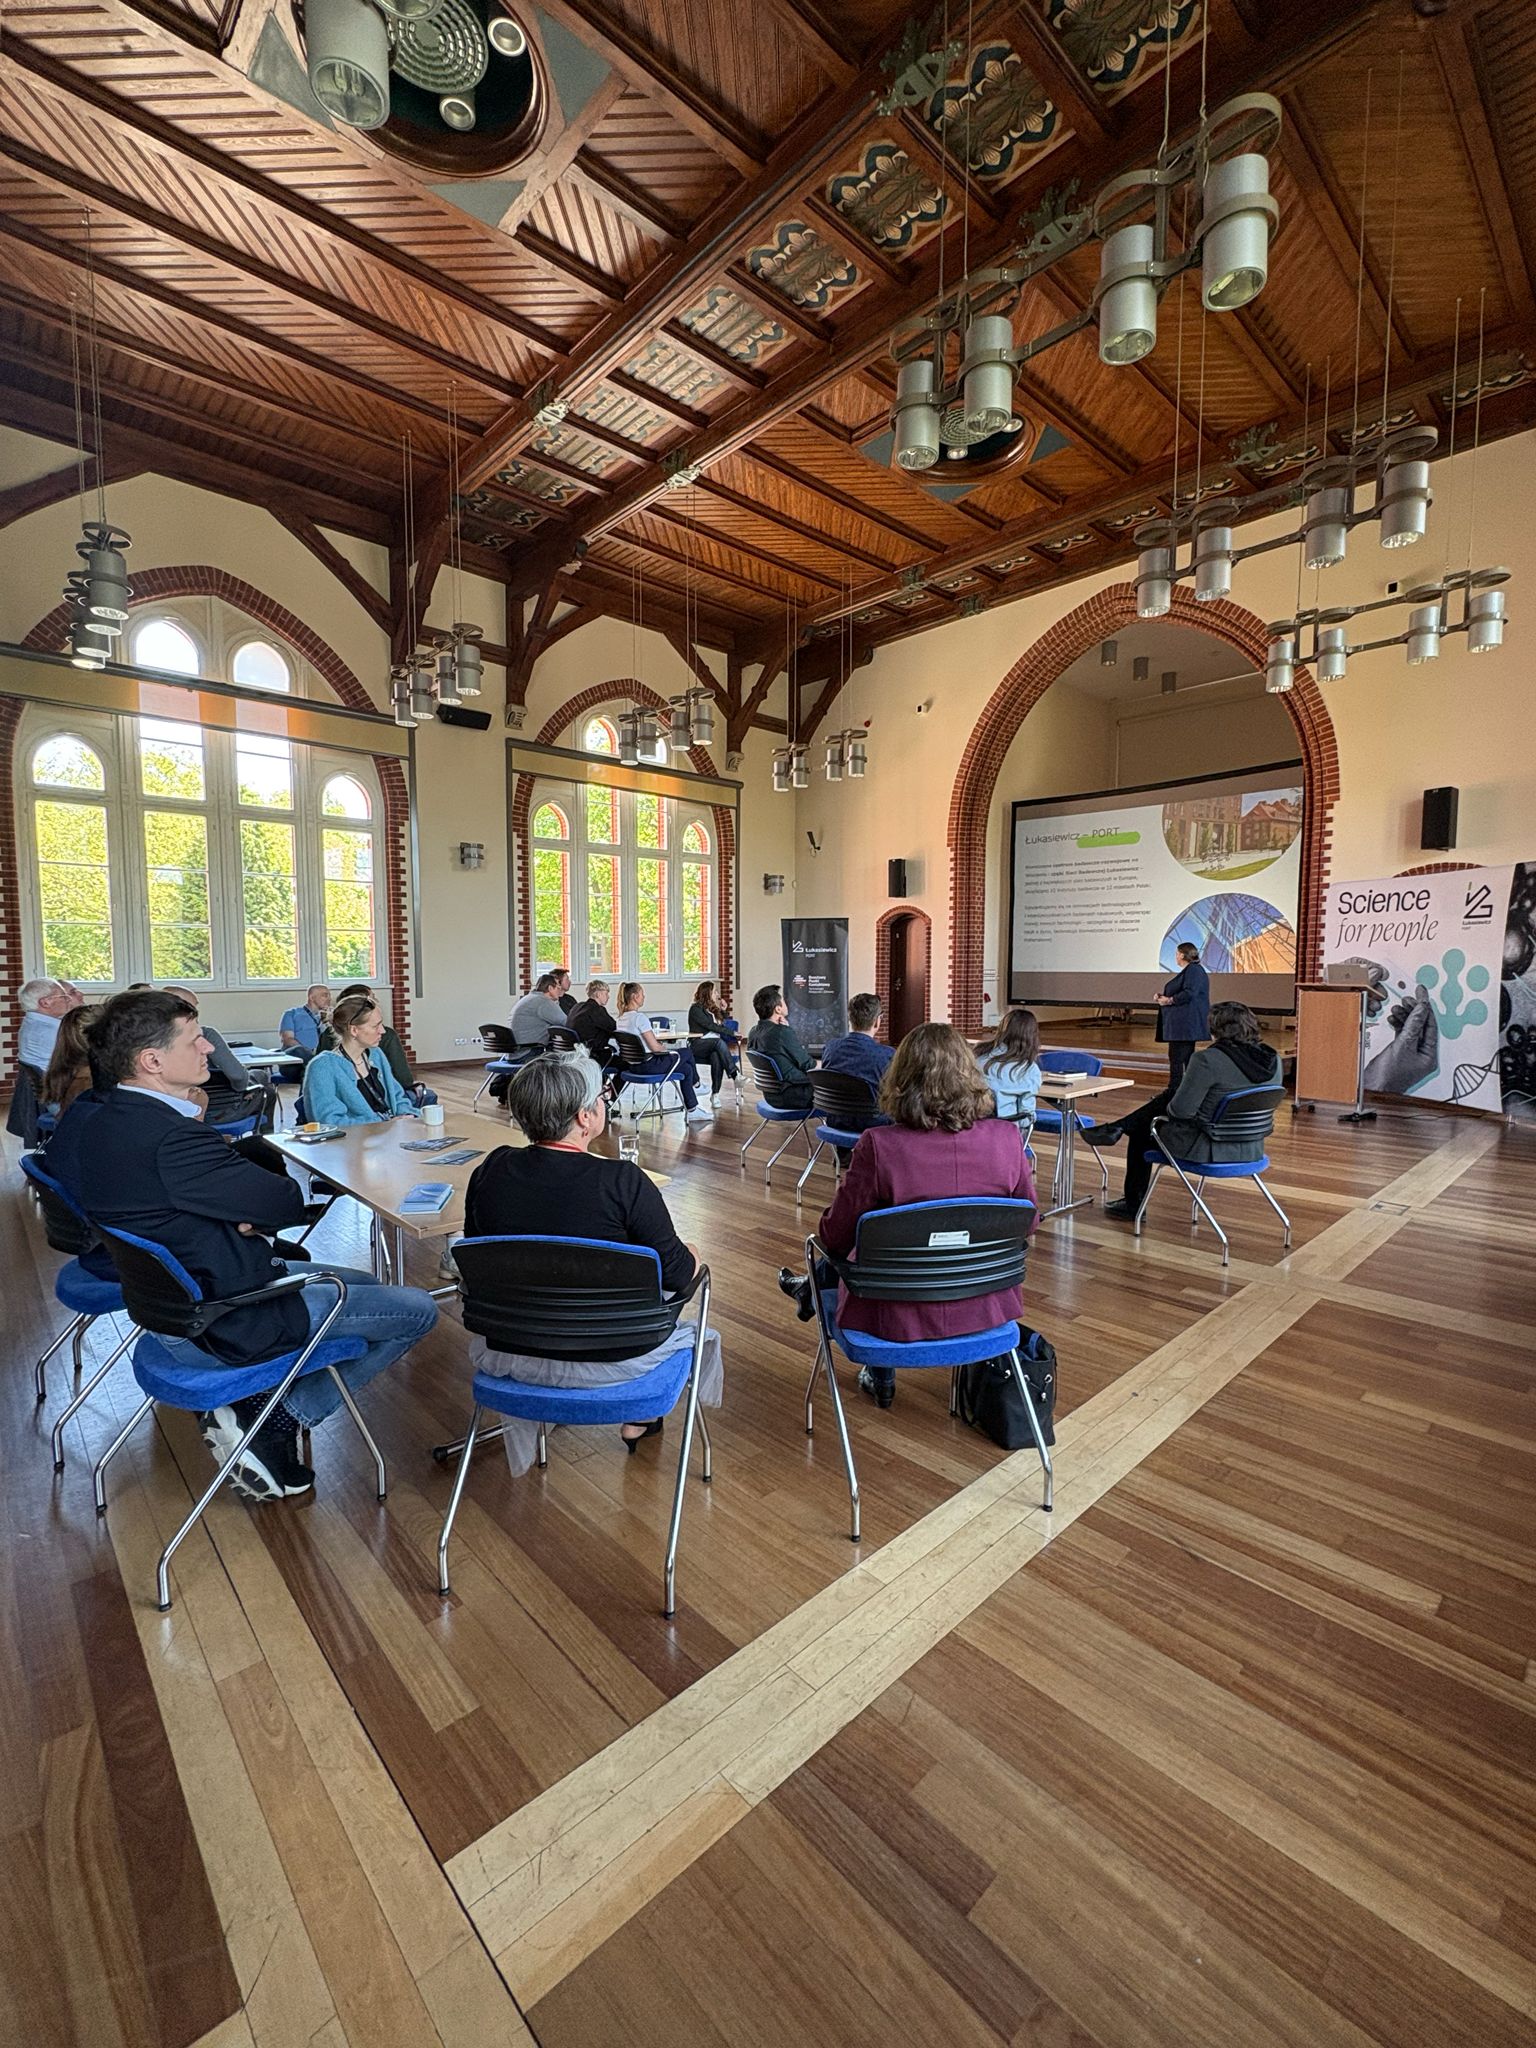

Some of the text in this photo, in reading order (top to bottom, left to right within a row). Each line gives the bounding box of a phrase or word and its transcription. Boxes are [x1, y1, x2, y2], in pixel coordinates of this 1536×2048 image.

[1025, 832, 1081, 845] Łukasiewicz
[1092, 827, 1120, 838] PORT
[1338, 889, 1430, 914] Science
[1335, 914, 1439, 948] for people
